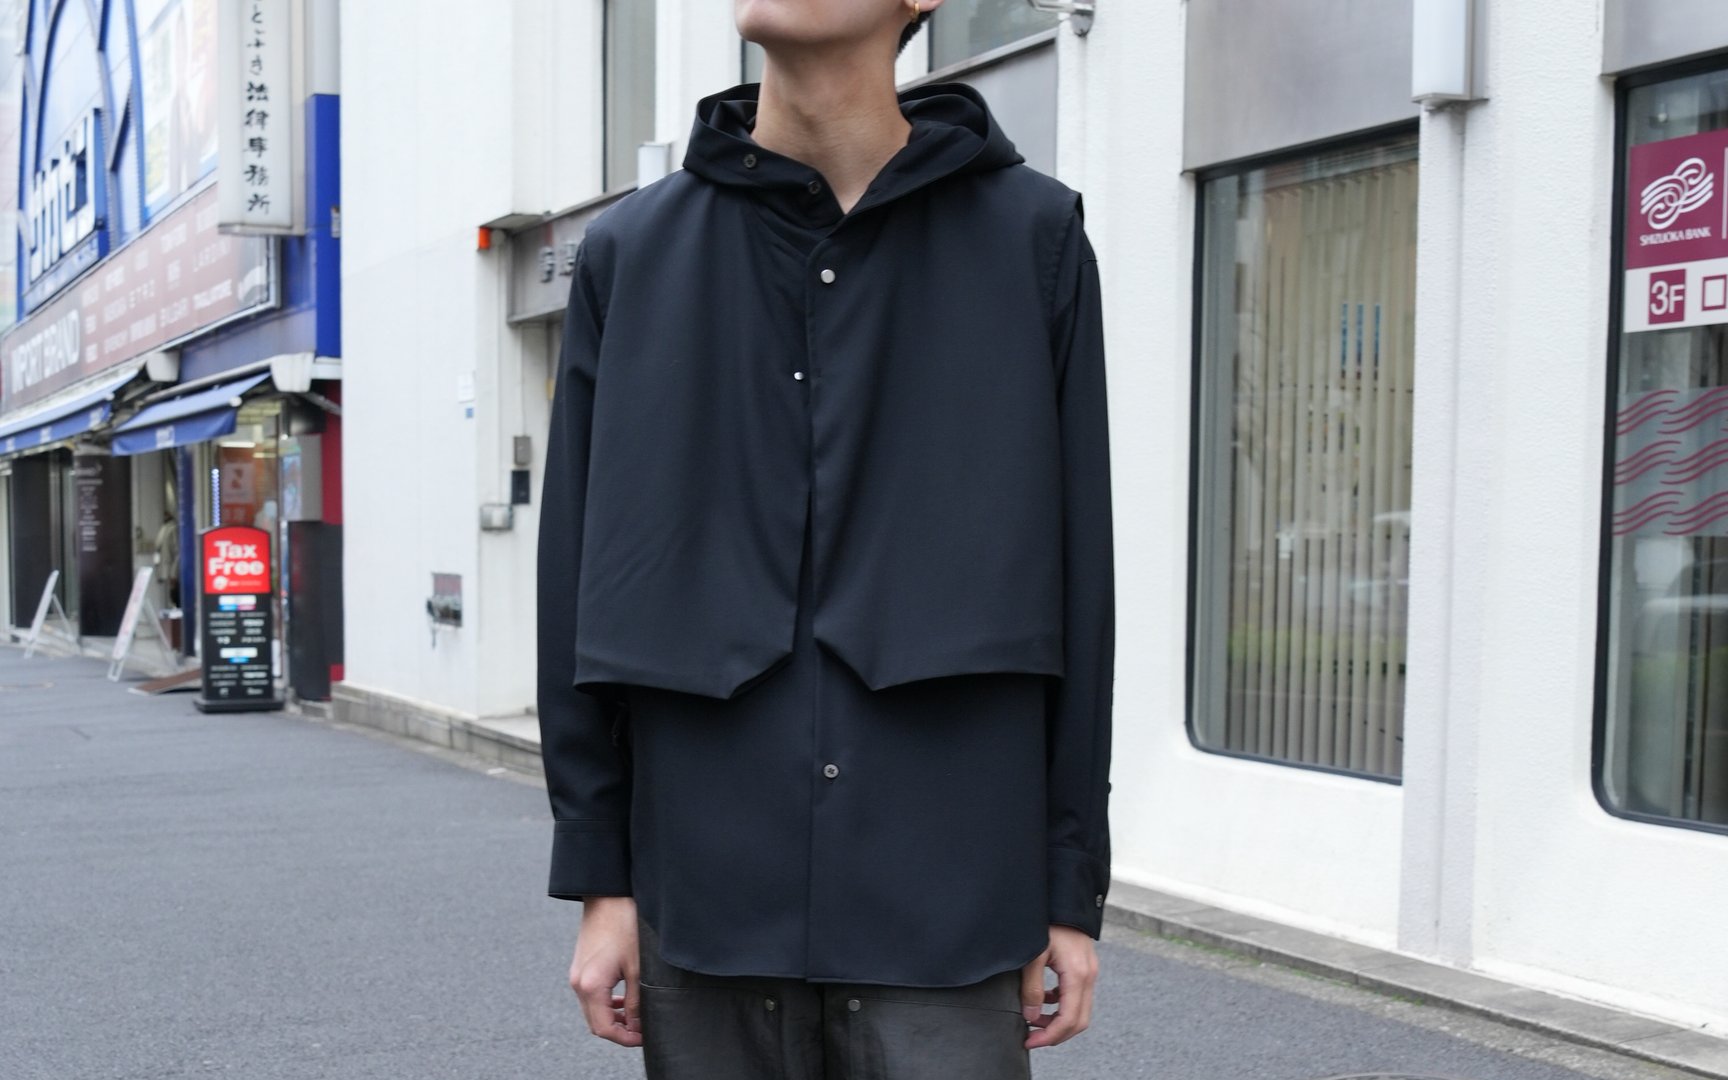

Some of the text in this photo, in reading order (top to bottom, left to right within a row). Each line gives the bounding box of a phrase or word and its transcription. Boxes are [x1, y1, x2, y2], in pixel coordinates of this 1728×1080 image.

[243, 0, 270, 215] とぶき法律事務所
[1639, 227, 1711, 246] SHIZUOKA BANK
[1650, 280, 1685, 315] 3F
[213, 540, 257, 560] Tax
[208, 557, 265, 576] Free
